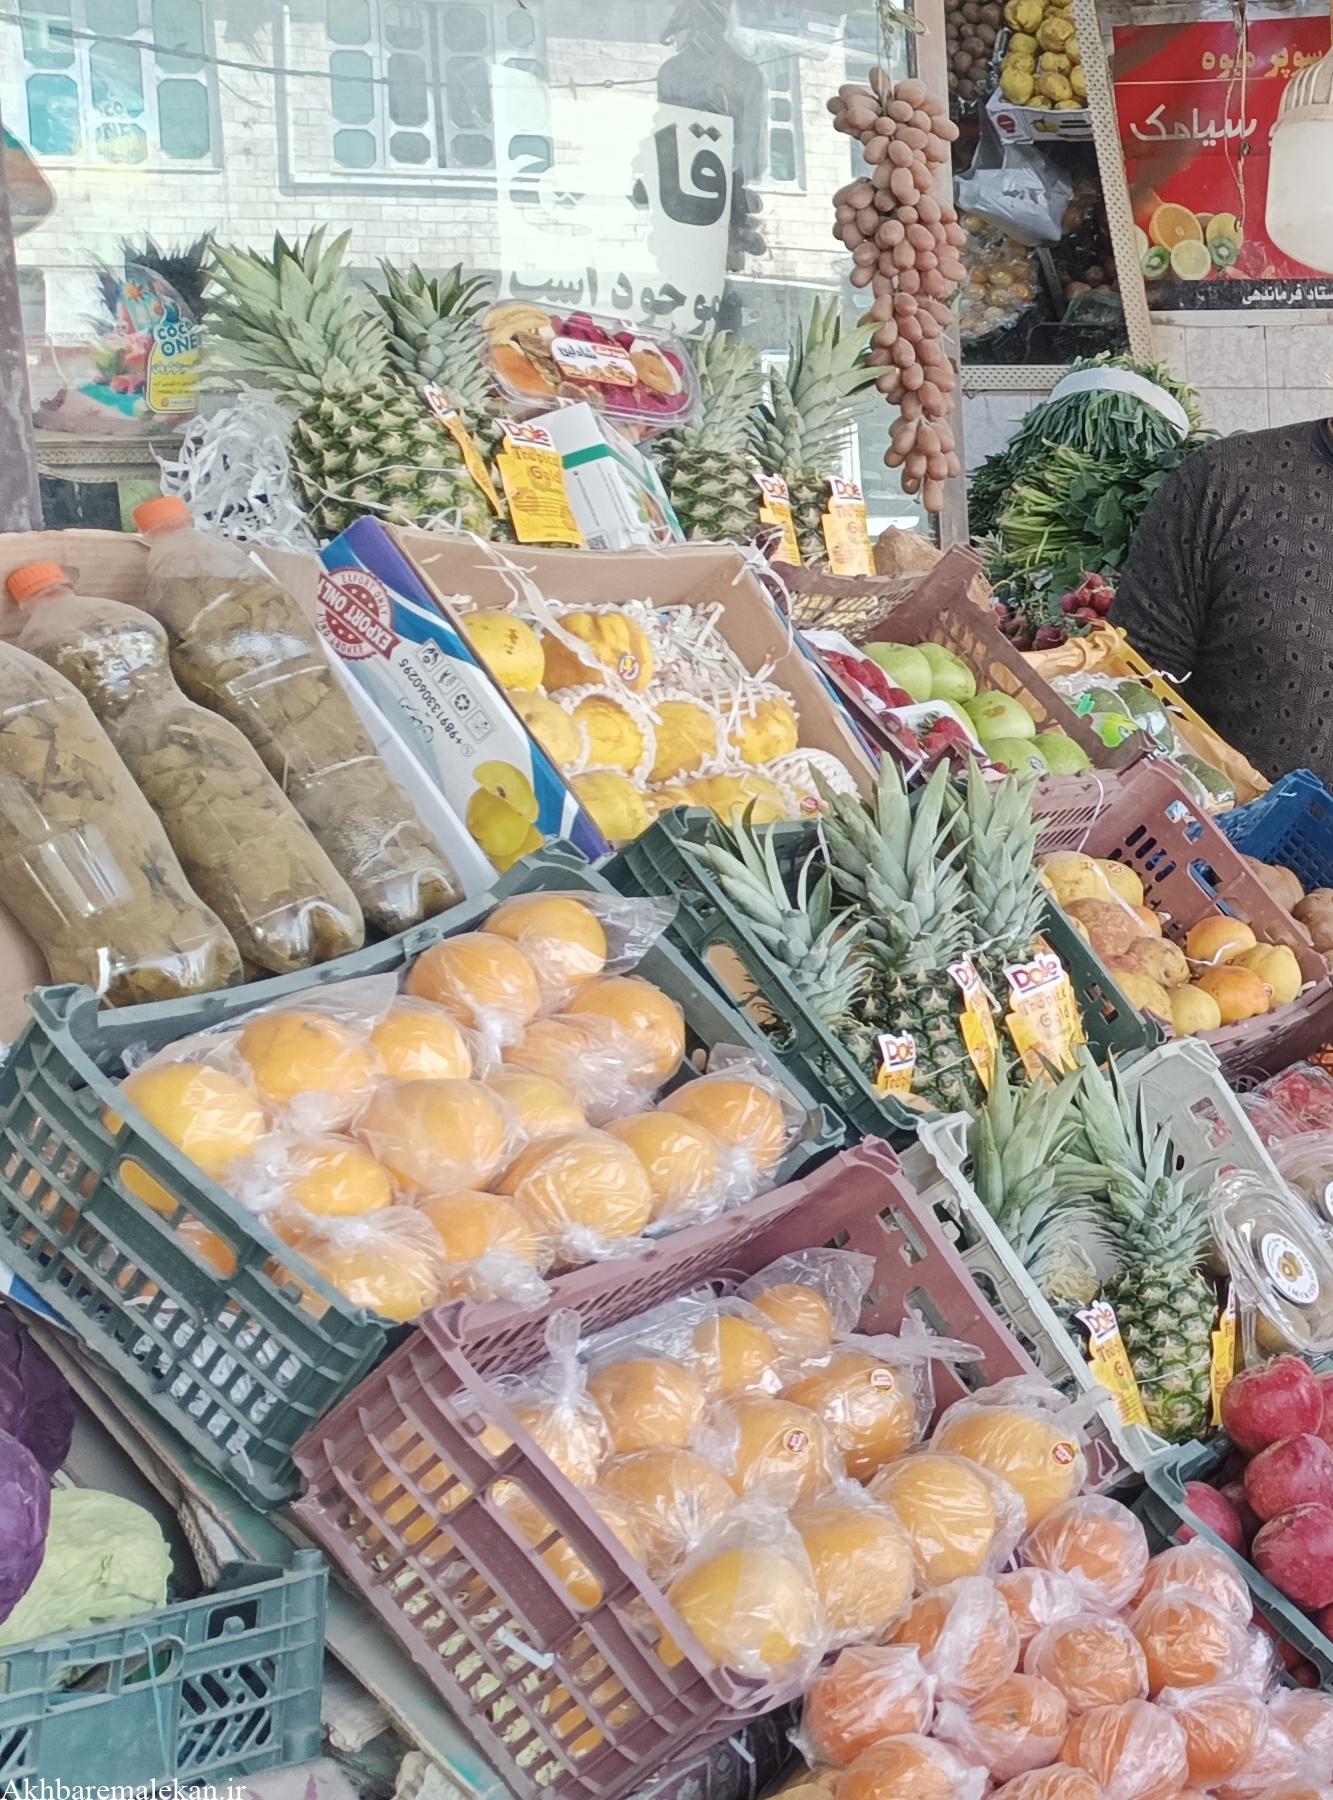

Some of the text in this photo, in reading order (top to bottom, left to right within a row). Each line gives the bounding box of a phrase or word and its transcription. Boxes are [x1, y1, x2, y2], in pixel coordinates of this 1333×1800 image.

[1130, 104, 1257, 147] سیامک
[1242, 283, 1302, 305] فرماندهی
[161, 335, 198, 357] ONE
[503, 421, 550, 442] Dole
[343, 604, 394, 651] EXPORT
[1011, 959, 1057, 989] Dole
[1084, 1307, 1114, 1334] Dole
